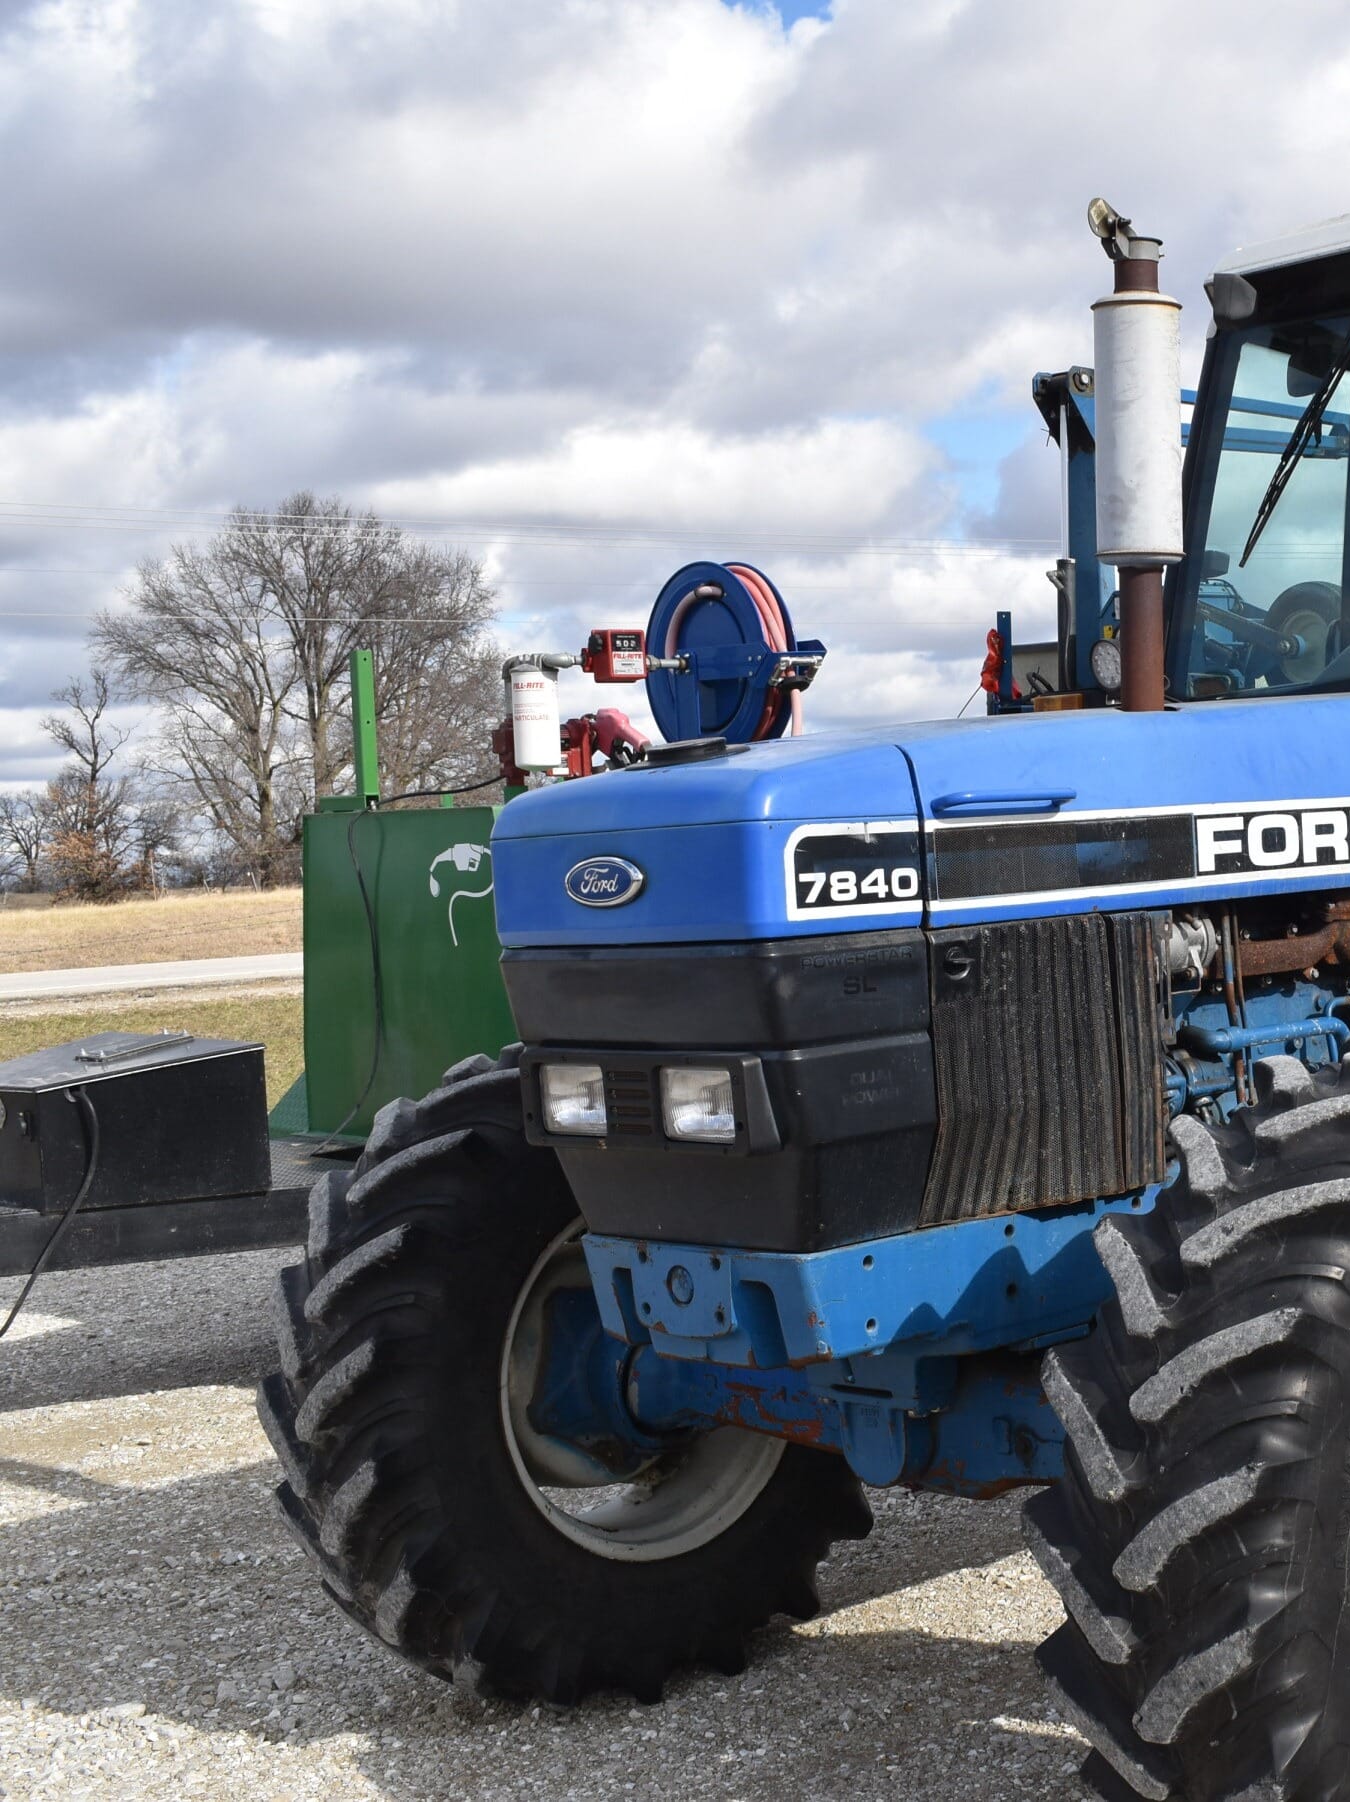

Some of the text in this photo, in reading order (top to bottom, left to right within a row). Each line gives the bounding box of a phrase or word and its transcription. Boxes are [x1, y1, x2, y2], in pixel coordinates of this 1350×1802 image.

[581, 868, 619, 893] Ford
[798, 867, 919, 904] 7840
[800, 946, 913, 969] POWERSTAR
[843, 976, 878, 994] SL
